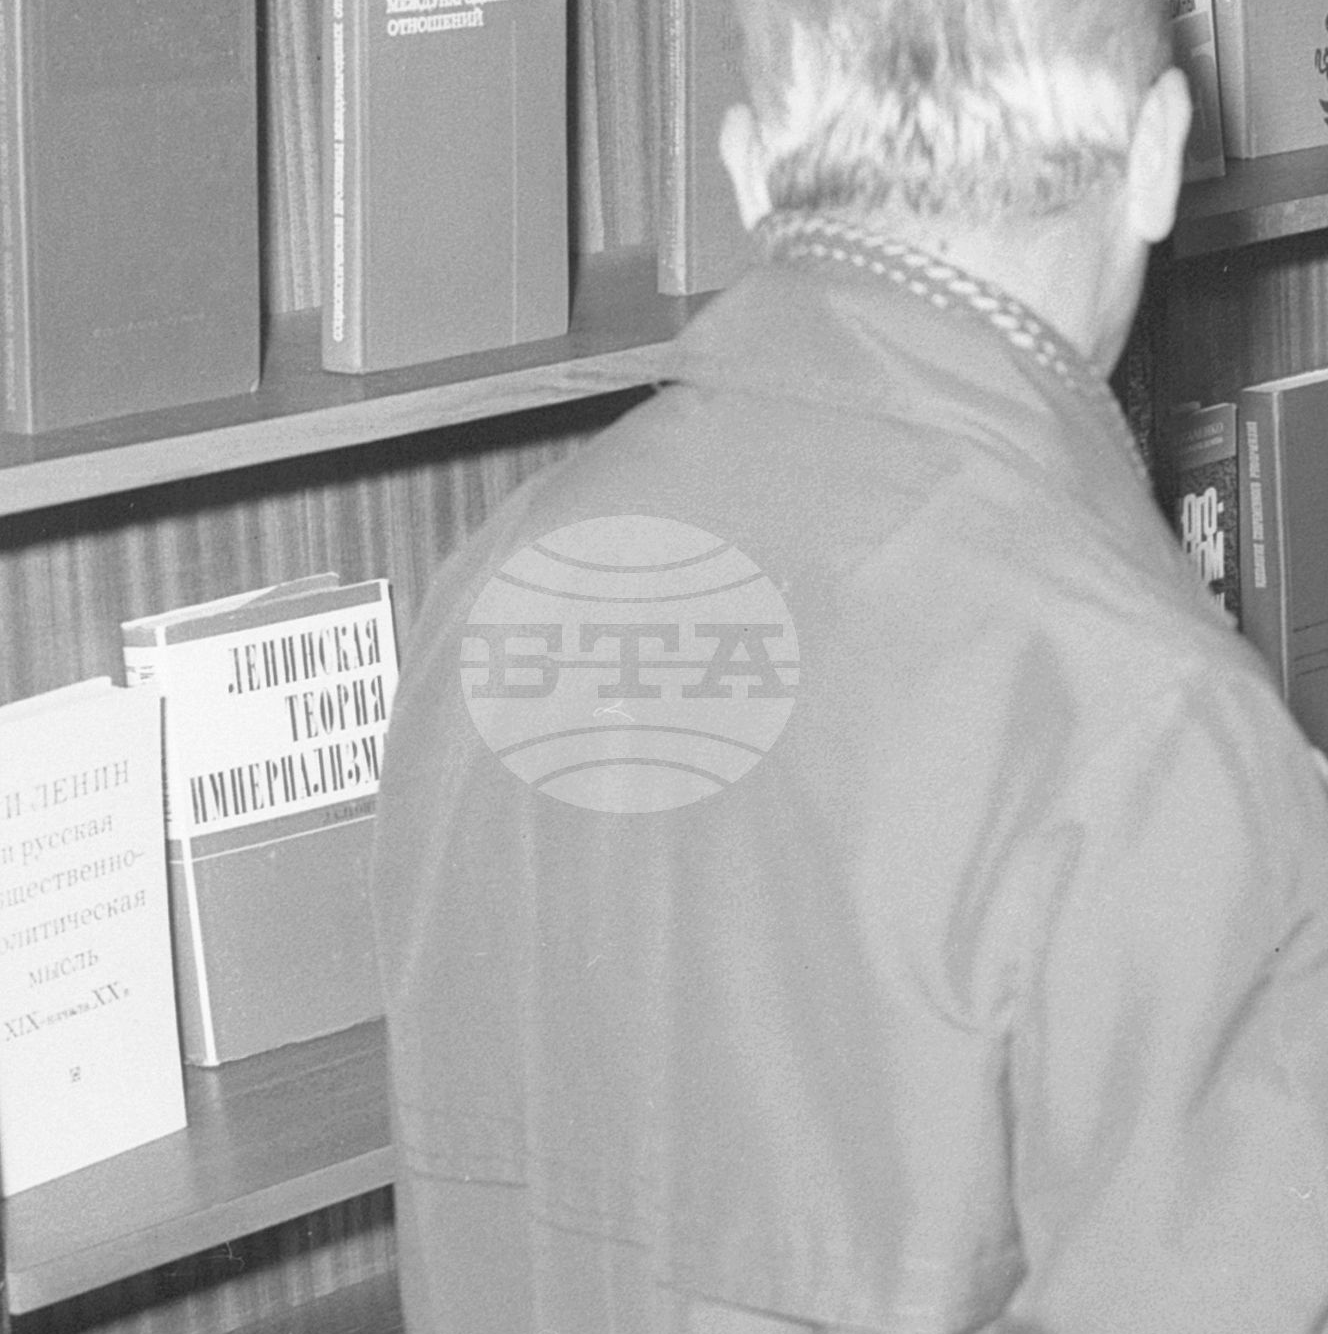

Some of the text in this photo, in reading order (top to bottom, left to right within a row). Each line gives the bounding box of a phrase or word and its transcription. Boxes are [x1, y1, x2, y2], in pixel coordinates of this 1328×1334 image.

[387, 7, 485, 37] ОТНОШЕНИЙ
[228, 618, 382, 694] ЛЕНИНСКАЯ
[286, 675, 387, 742] ТЕОРИЯ
[30, 758, 130, 813] ЛЕНИН
[190, 736, 381, 825] ИМПЕРИАЛИЗМ
[21, 814, 114, 867] русская
[27, 948, 101, 989] мысль
